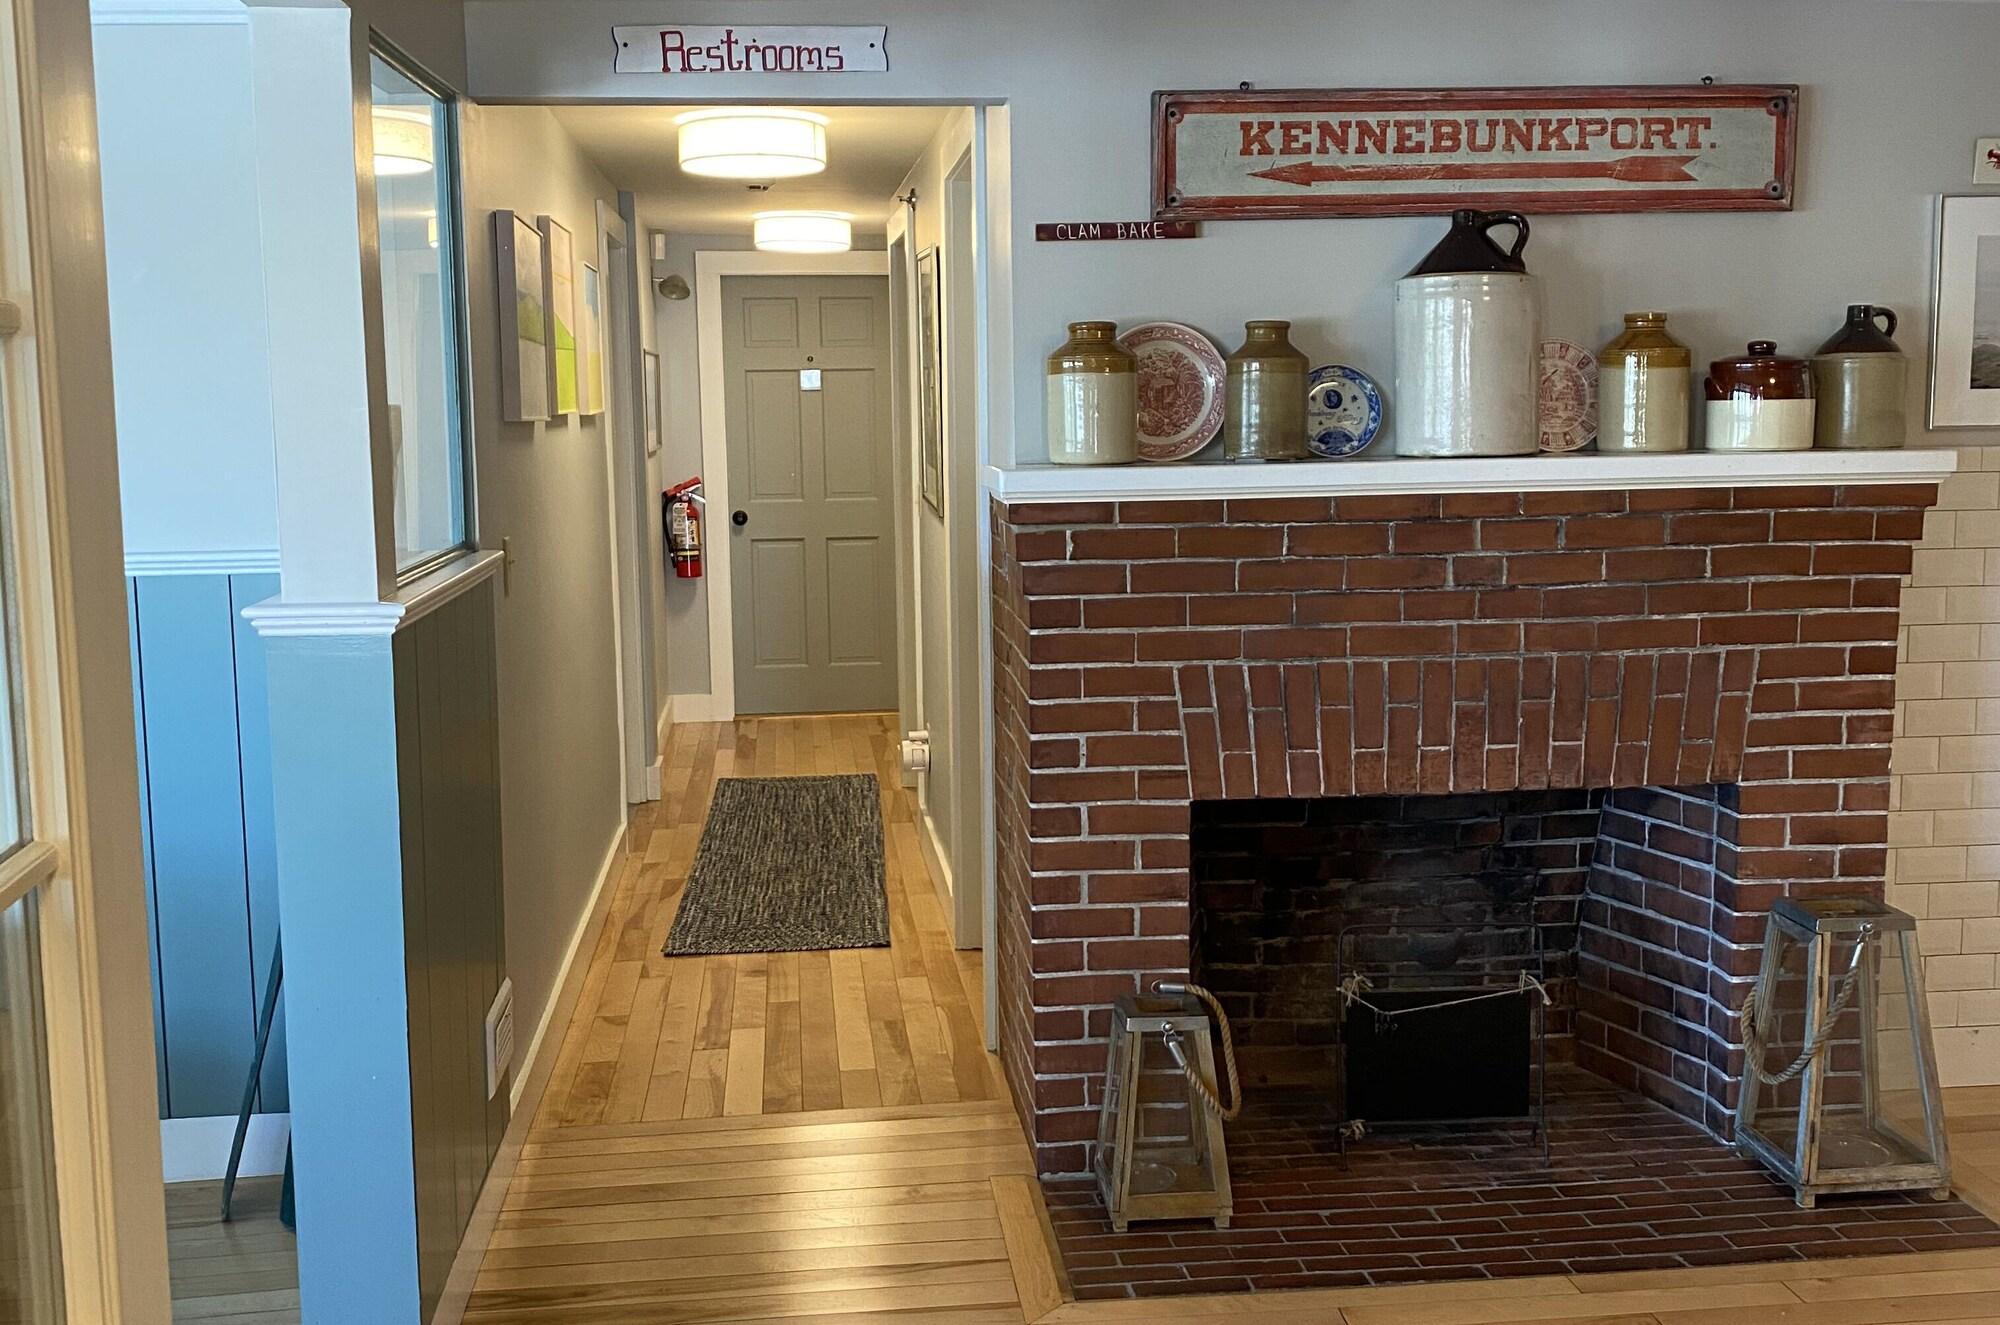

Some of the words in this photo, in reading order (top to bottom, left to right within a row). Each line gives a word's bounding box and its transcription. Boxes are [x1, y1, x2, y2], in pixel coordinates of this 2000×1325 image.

[659, 29, 844, 73] Restrooms
[1238, 116, 1718, 157] KENNEBUNKPORT.
[1056, 223, 1101, 240] CLAM
[1117, 221, 1166, 240] BAKE
